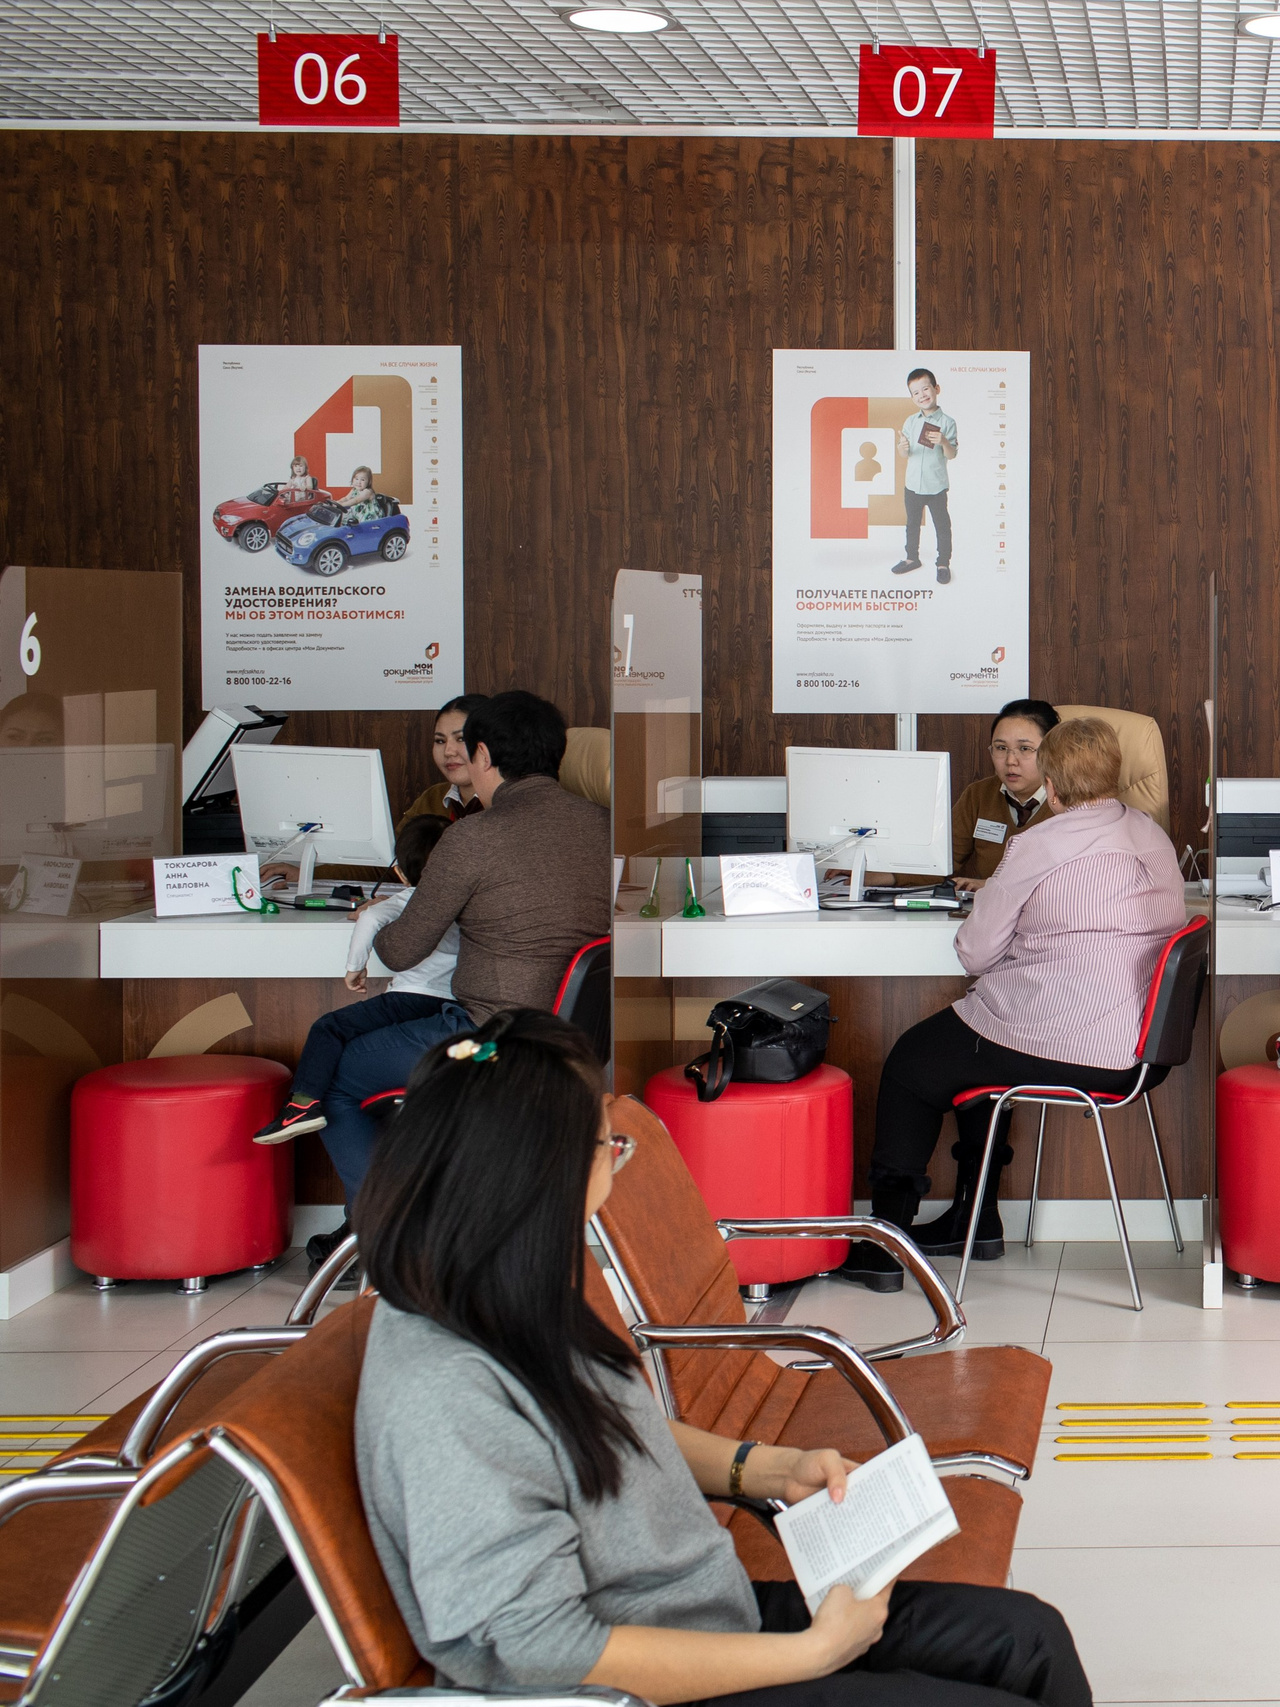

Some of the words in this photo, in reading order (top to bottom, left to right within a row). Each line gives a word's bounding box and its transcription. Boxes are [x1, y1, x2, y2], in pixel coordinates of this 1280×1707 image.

[295, 54, 365, 104] 06
[894, 66, 962, 116] 07
[225, 587, 276, 597] ЗАМЕНА
[279, 586, 385, 597] ВОДИТЕЛЬСКОГО
[796, 590, 867, 598] ПОЛУЧАЕТЕ
[871, 590, 933, 599] ПАСПОРТ?
[225, 598, 337, 608] УДОСТОВЕРЕНИЯ?
[796, 602, 862, 610] ОФОРМИМ
[866, 602, 917, 611] БЫСТРО!
[226, 611, 246, 620] МЫ
[249, 611, 266, 620] ОБ
[269, 611, 303, 620] ЭТОМ
[308, 610, 404, 619] ПОЗАБОТИМСЯ!
[20, 612, 41, 676] 6
[383, 668, 433, 677] документы
